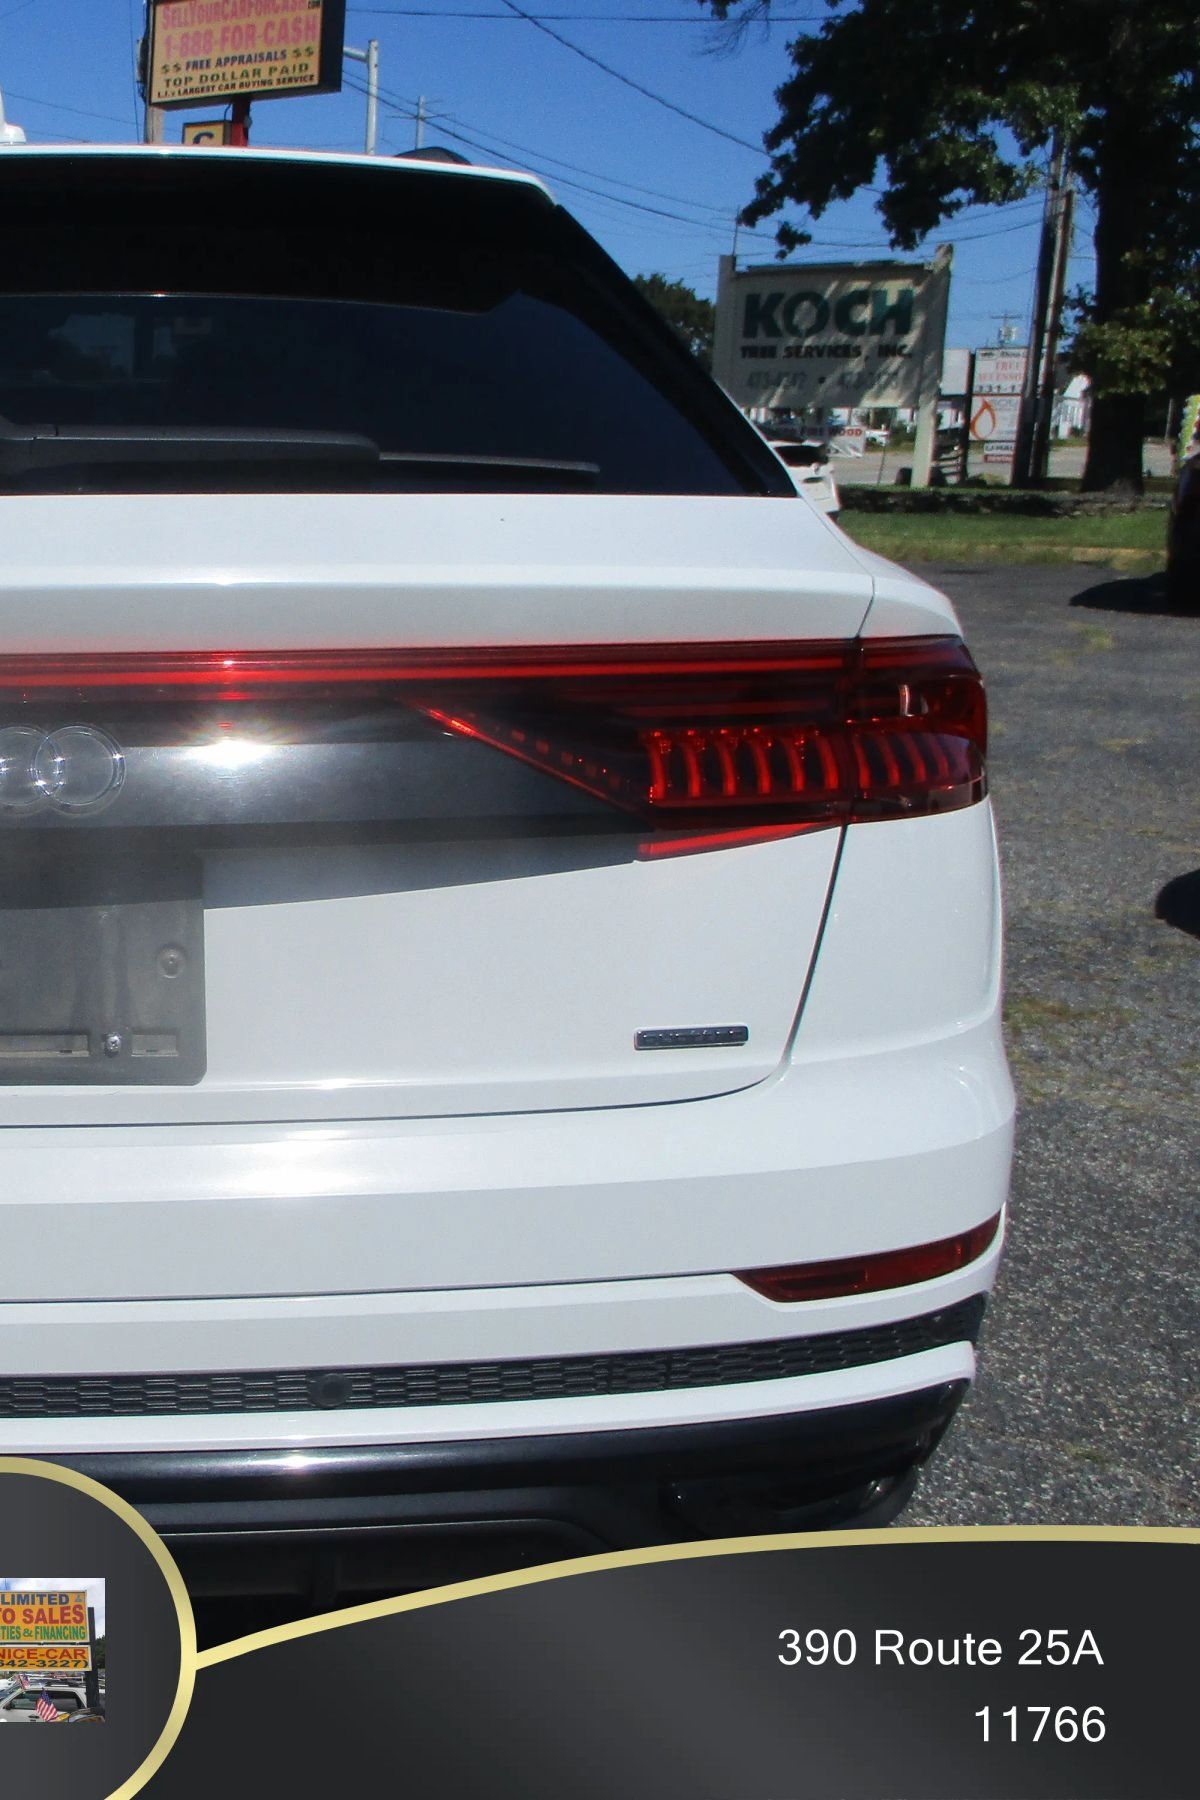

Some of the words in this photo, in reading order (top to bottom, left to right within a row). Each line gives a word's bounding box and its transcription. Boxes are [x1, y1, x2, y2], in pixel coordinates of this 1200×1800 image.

[185, 58, 211, 71] FREE
[215, 48, 287, 68] APPRAISALS
[164, 75, 193, 88] TOP
[200, 69, 261, 85] DOLLAR
[269, 62, 309, 77] PAID
[177, 84, 216, 96] LARGEST
[218, 82, 236, 92] CAR
[239, 79, 273, 90] BUYING
[276, 74, 314, 86] SERVICE
[742, 289, 915, 338] KOCH
